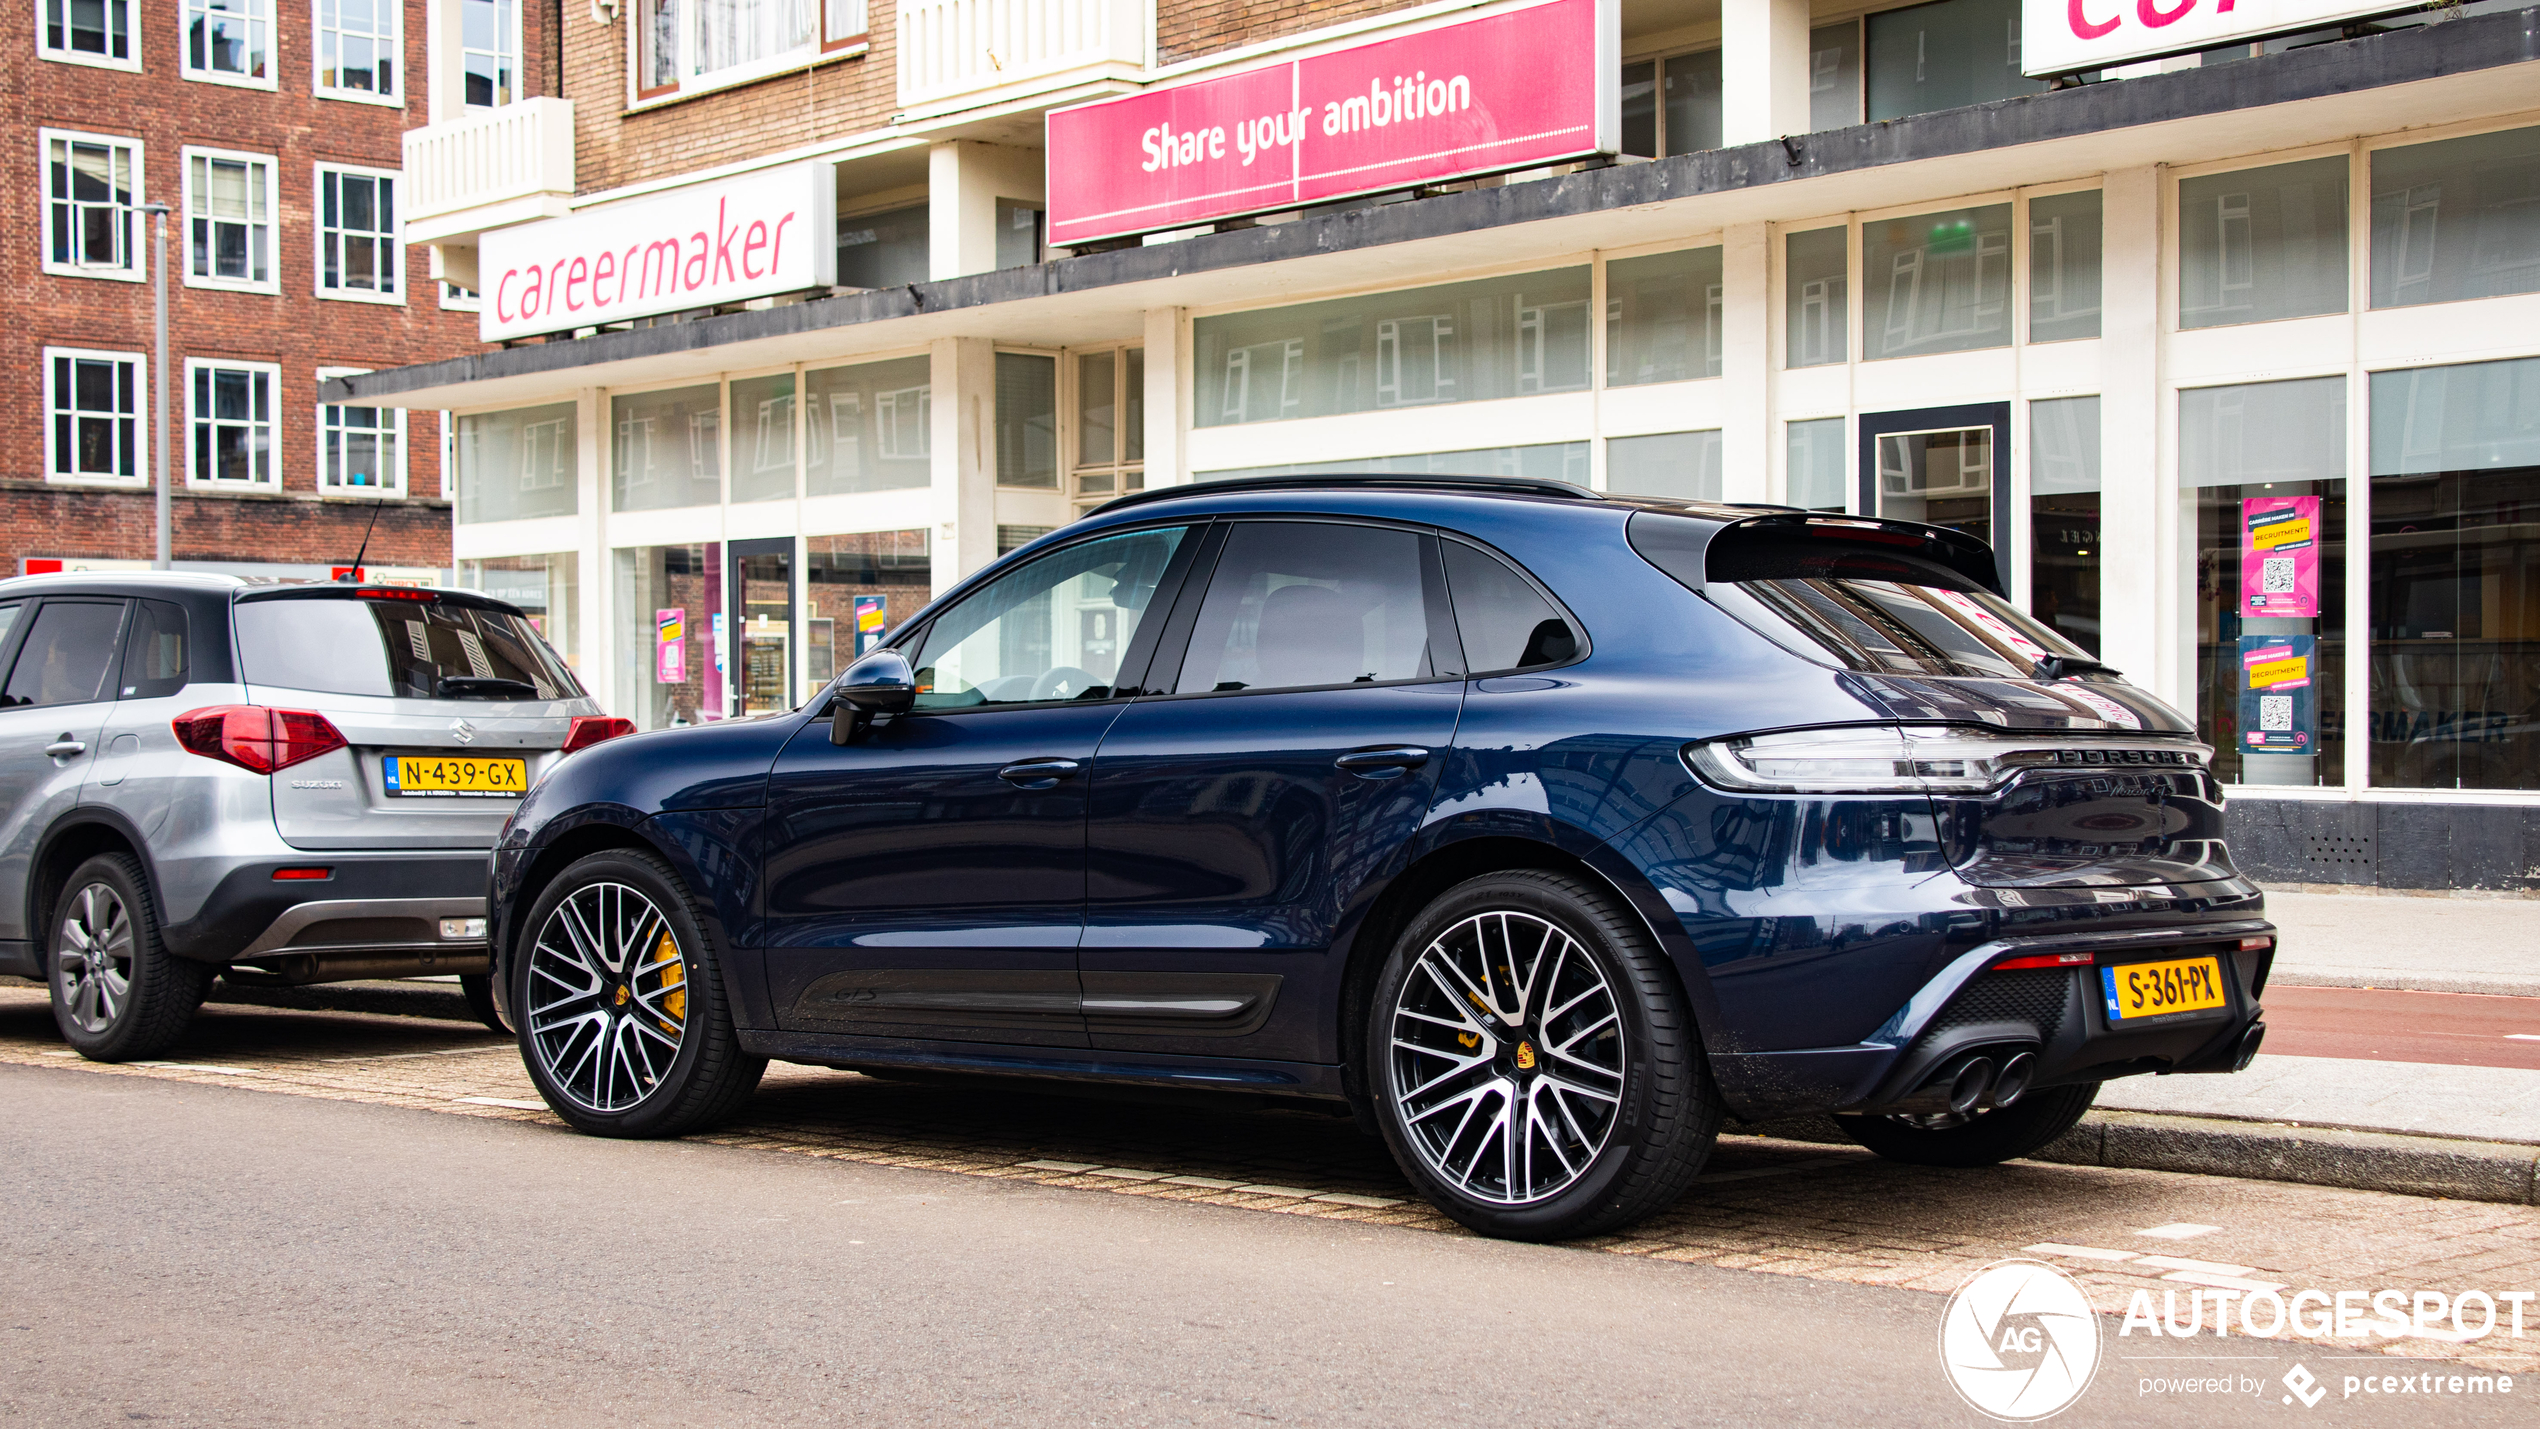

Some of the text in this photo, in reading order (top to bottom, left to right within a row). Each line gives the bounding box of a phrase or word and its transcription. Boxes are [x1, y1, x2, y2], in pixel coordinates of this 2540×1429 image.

[1142, 70, 1471, 173] Share your ambition
[497, 194, 796, 324] careermaker
[2255, 526, 2308, 541] RECRUITMENT?
[2251, 665, 2304, 679] RECRUITMENT?
[2061, 750, 2185, 765] PORSCHE
[387, 776, 399, 784] NL
[405, 761, 517, 786] N-439-GX
[291, 780, 342, 789] SUZUKI
[2128, 964, 2216, 1009] S-361-PX
[2107, 998, 2119, 1011] NL
[1624, 1061, 1647, 1127] PIRELLI
